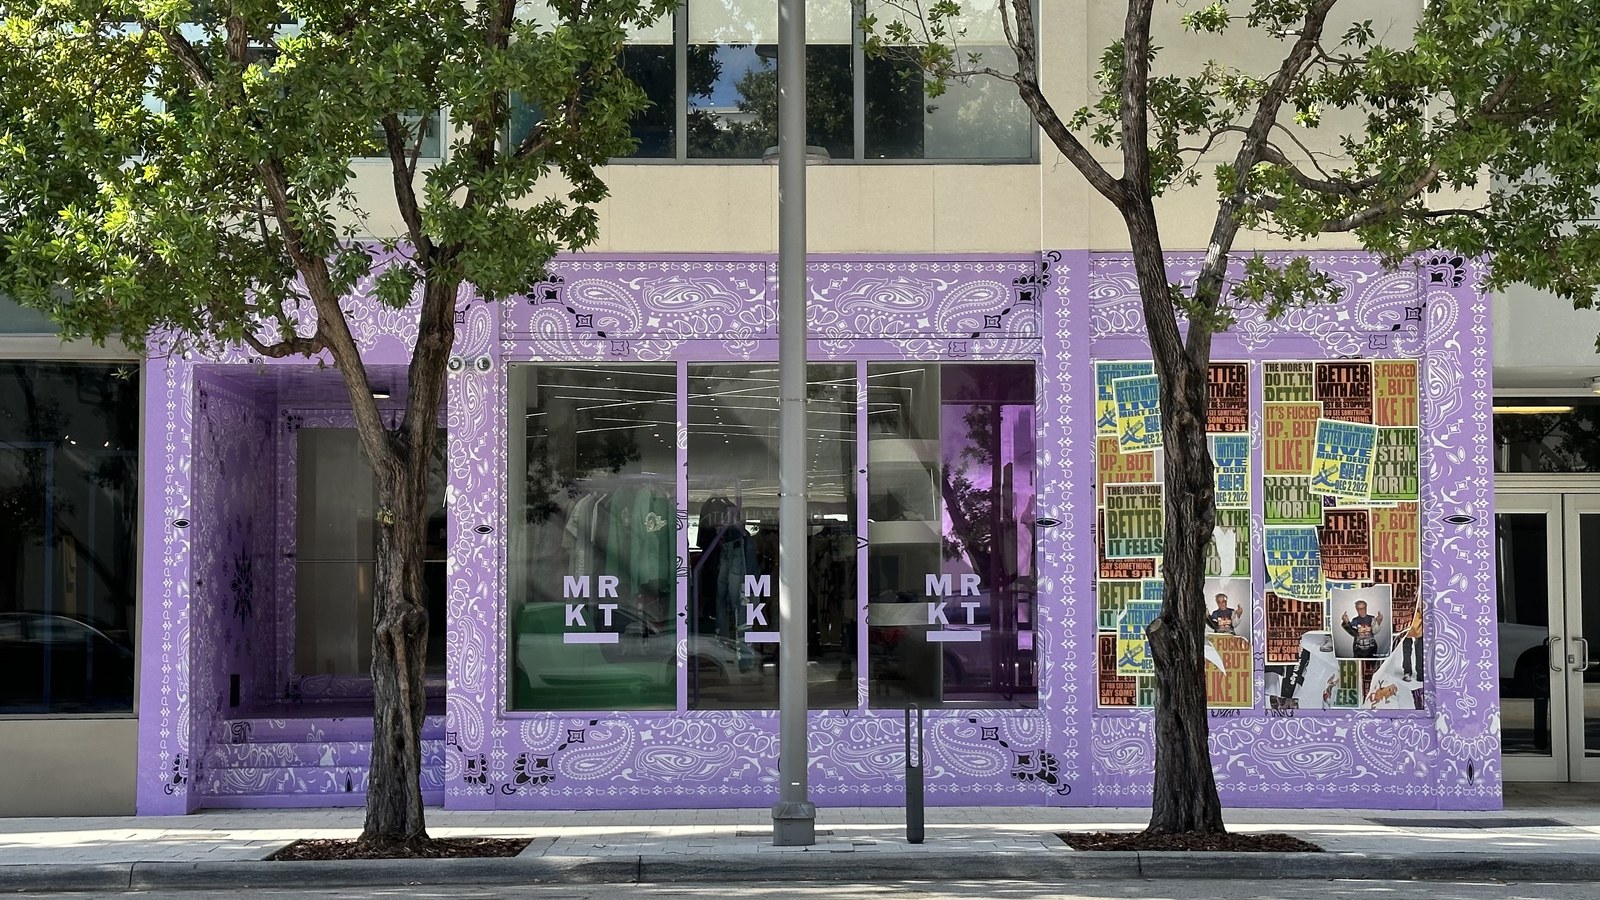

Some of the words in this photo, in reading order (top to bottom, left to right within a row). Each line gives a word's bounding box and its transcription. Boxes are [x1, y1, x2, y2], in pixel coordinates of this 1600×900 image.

[1208, 365, 1246, 382] ETTER
[1265, 363, 1279, 372] THE
[1281, 363, 1302, 372] MORE
[1304, 363, 1313, 372] YO
[1318, 365, 1369, 382] BETTER
[1382, 364, 1415, 377] FUCKED
[1265, 374, 1280, 386] DO
[1284, 373, 1295, 387] IT,
[1298, 373, 1312, 386] TH
[1388, 379, 1414, 395] BUT
[1117, 386, 1140, 402] BETTER
[1226, 384, 1246, 397] AGE
[1318, 383, 1347, 397] WITH
[1350, 383, 1370, 397] AGE
[1118, 400, 1158, 411] LIV
[1266, 406, 1284, 419] IT'S
[1287, 406, 1320, 419] FUCKED
[1378, 398, 1397, 425] IKE
[1402, 398, 1414, 425] IT
[1225, 424, 1246, 432] 911
[1267, 421, 1289, 438] UP,
[1318, 429, 1342, 445] BETTER
[1342, 431, 1361, 448] WITH
[1360, 433, 1374, 450] AGE
[1394, 430, 1416, 446] THE
[1100, 439, 1117, 453] IT'S
[1217, 444, 1234, 458] WITH
[1317, 444, 1372, 458] LIVE
[1267, 440, 1271, 470] I
[1275, 440, 1302, 470] LIKE
[1307, 440, 1314, 470] I
[1317, 452, 1344, 460] MRKT
[1346, 455, 1370, 464] DEUX
[1379, 446, 1416, 461] STEM
[1100, 454, 1122, 472] UP,
[1126, 454, 1152, 470] BUT
[1391, 462, 1416, 476] THE
[1265, 477, 1311, 486] SYSTE
[1335, 479, 1347, 490] DEC
[1348, 481, 1352, 491] 2
[1353, 482, 1368, 493] 2022
[1373, 477, 1417, 493] ORLD
[1107, 486, 1121, 495] THE
[1123, 486, 1144, 495] MORE
[1146, 485, 1161, 494] YOU
[1216, 492, 1226, 502] DEC
[1228, 492, 1232, 502] 2
[1233, 491, 1247, 502] 2022
[1266, 487, 1291, 500] NOT
[1108, 496, 1123, 509] DO
[1126, 496, 1138, 510] IT,
[1140, 496, 1161, 508] THE
[1266, 501, 1320, 518] WORLD
[1107, 510, 1162, 538] BETTER
[1226, 511, 1248, 526] THE
[1325, 513, 1366, 529] ETTER
[1372, 513, 1385, 530] P,
[1390, 513, 1416, 529] BUT
[1268, 536, 1290, 550] BETTER
[1346, 530, 1367, 544] AGE
[1109, 540, 1122, 555] IT
[1126, 539, 1163, 554] FEELS
[1404, 532, 1416, 562] IT
[1268, 551, 1321, 559] LIVE
[1101, 570, 1129, 578] DIAL
[1331, 563, 1369, 571] SOMETHING.
[745, 574, 771, 597] M
[1302, 585, 1306, 594] 2
[1307, 584, 1322, 594] 2022
[1099, 582, 1141, 609] BETT
[746, 603, 768, 626] K
[1101, 611, 1113, 626] IT
[1269, 613, 1298, 627] WITH
[1300, 613, 1321, 627] AGE
[1223, 653, 1249, 669] BUT
[1237, 672, 1249, 702] IT
